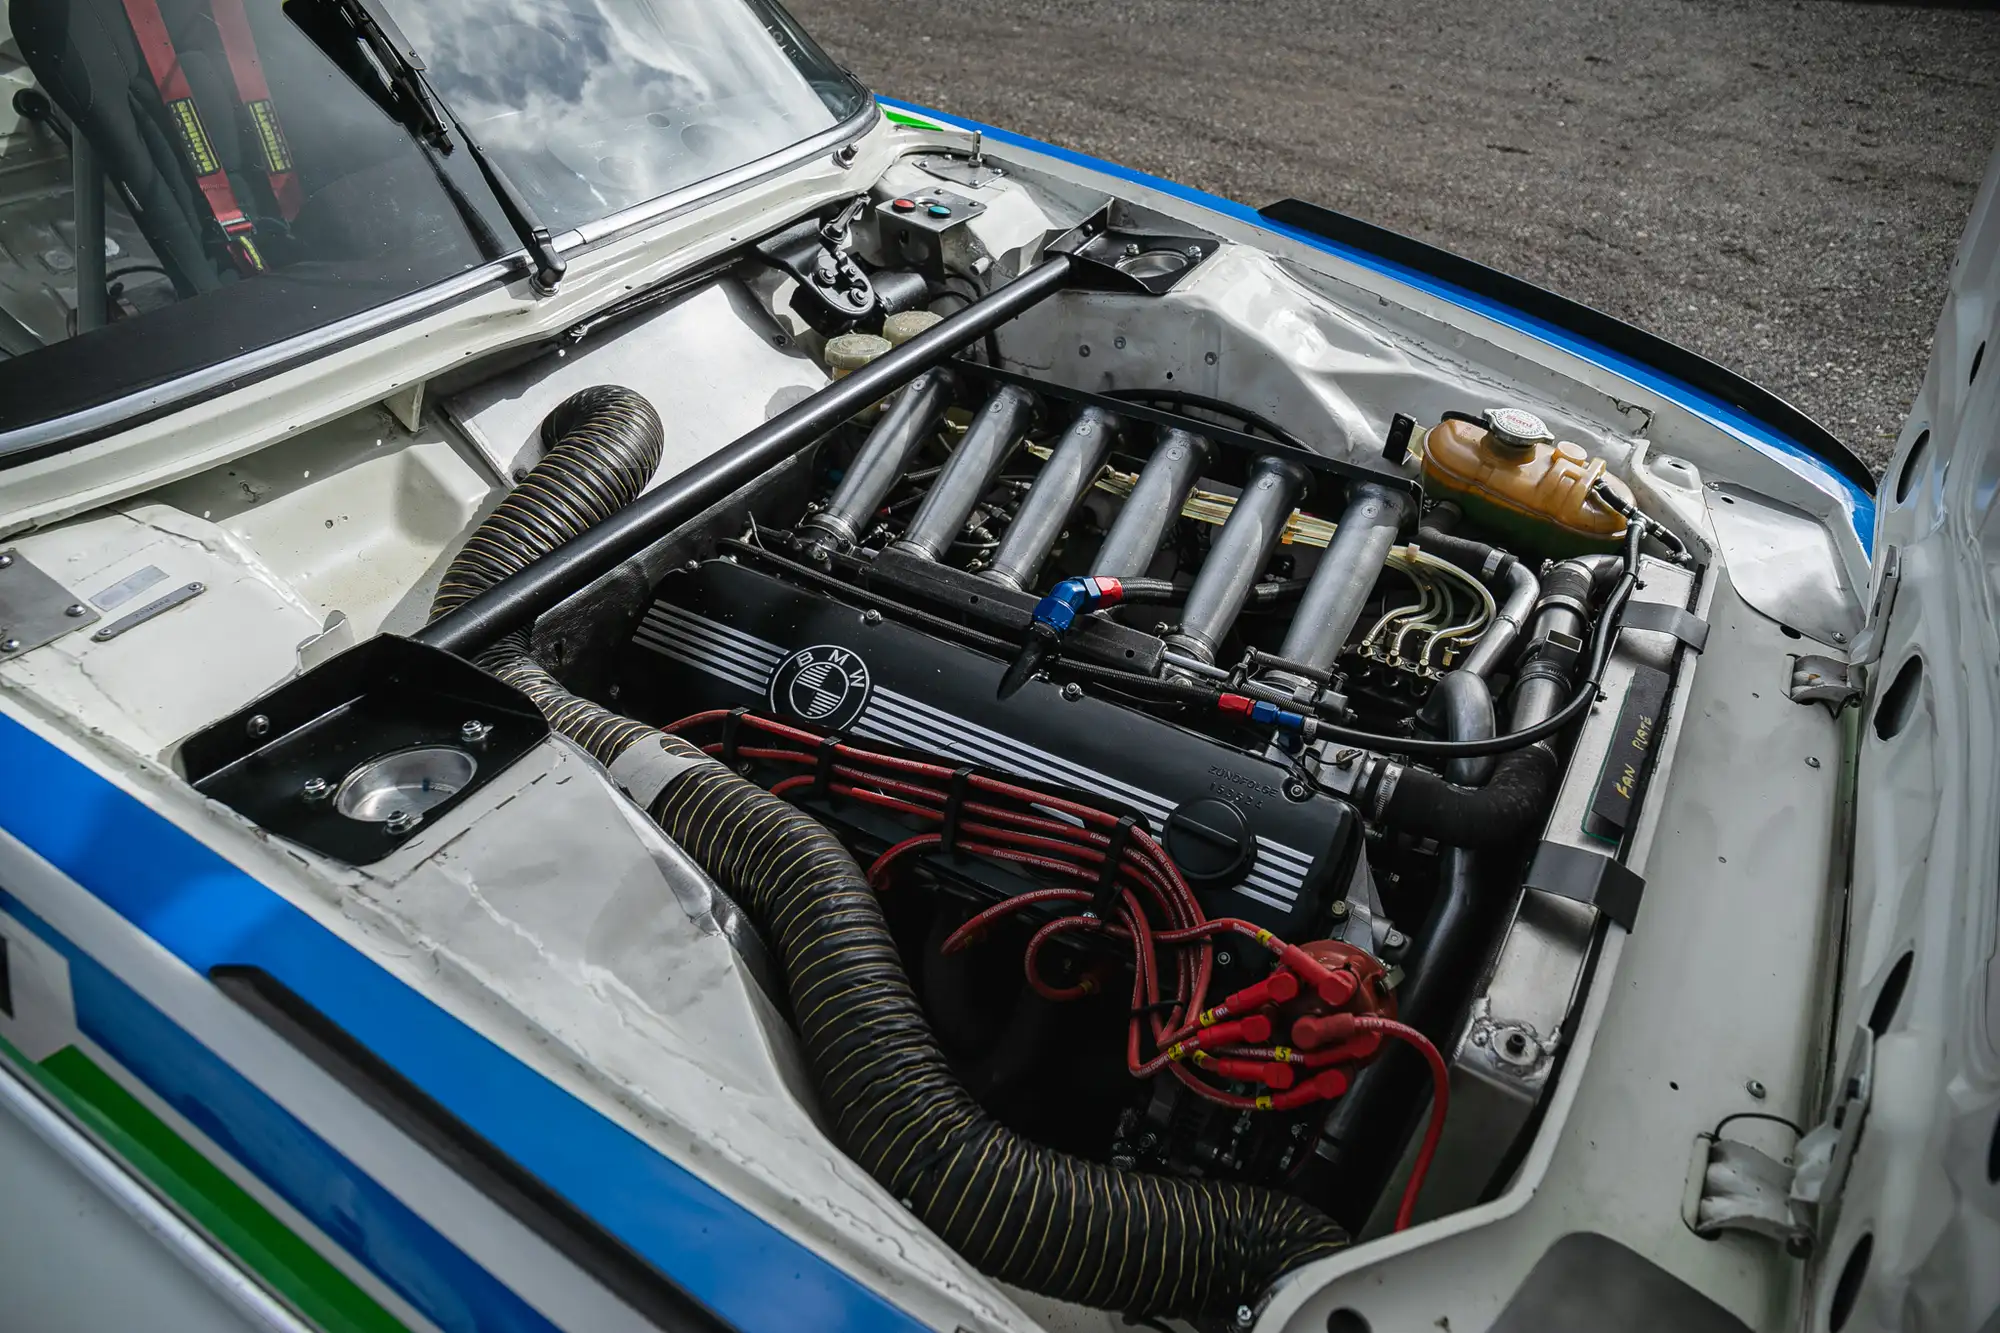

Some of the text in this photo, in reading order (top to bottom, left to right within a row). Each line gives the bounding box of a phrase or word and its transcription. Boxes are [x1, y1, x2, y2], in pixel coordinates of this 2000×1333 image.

[796, 649, 866, 688] BMW
[1615, 713, 1653, 801] FAN PLATE
[1040, 860, 1078, 876] COMPETITION
[1140, 856, 1173, 892] COMPETITION
[1163, 861, 1189, 901] COMPETITION
[1035, 887, 1077, 898] COMPETITION
[1042, 918, 1084, 936] COMPETITION
